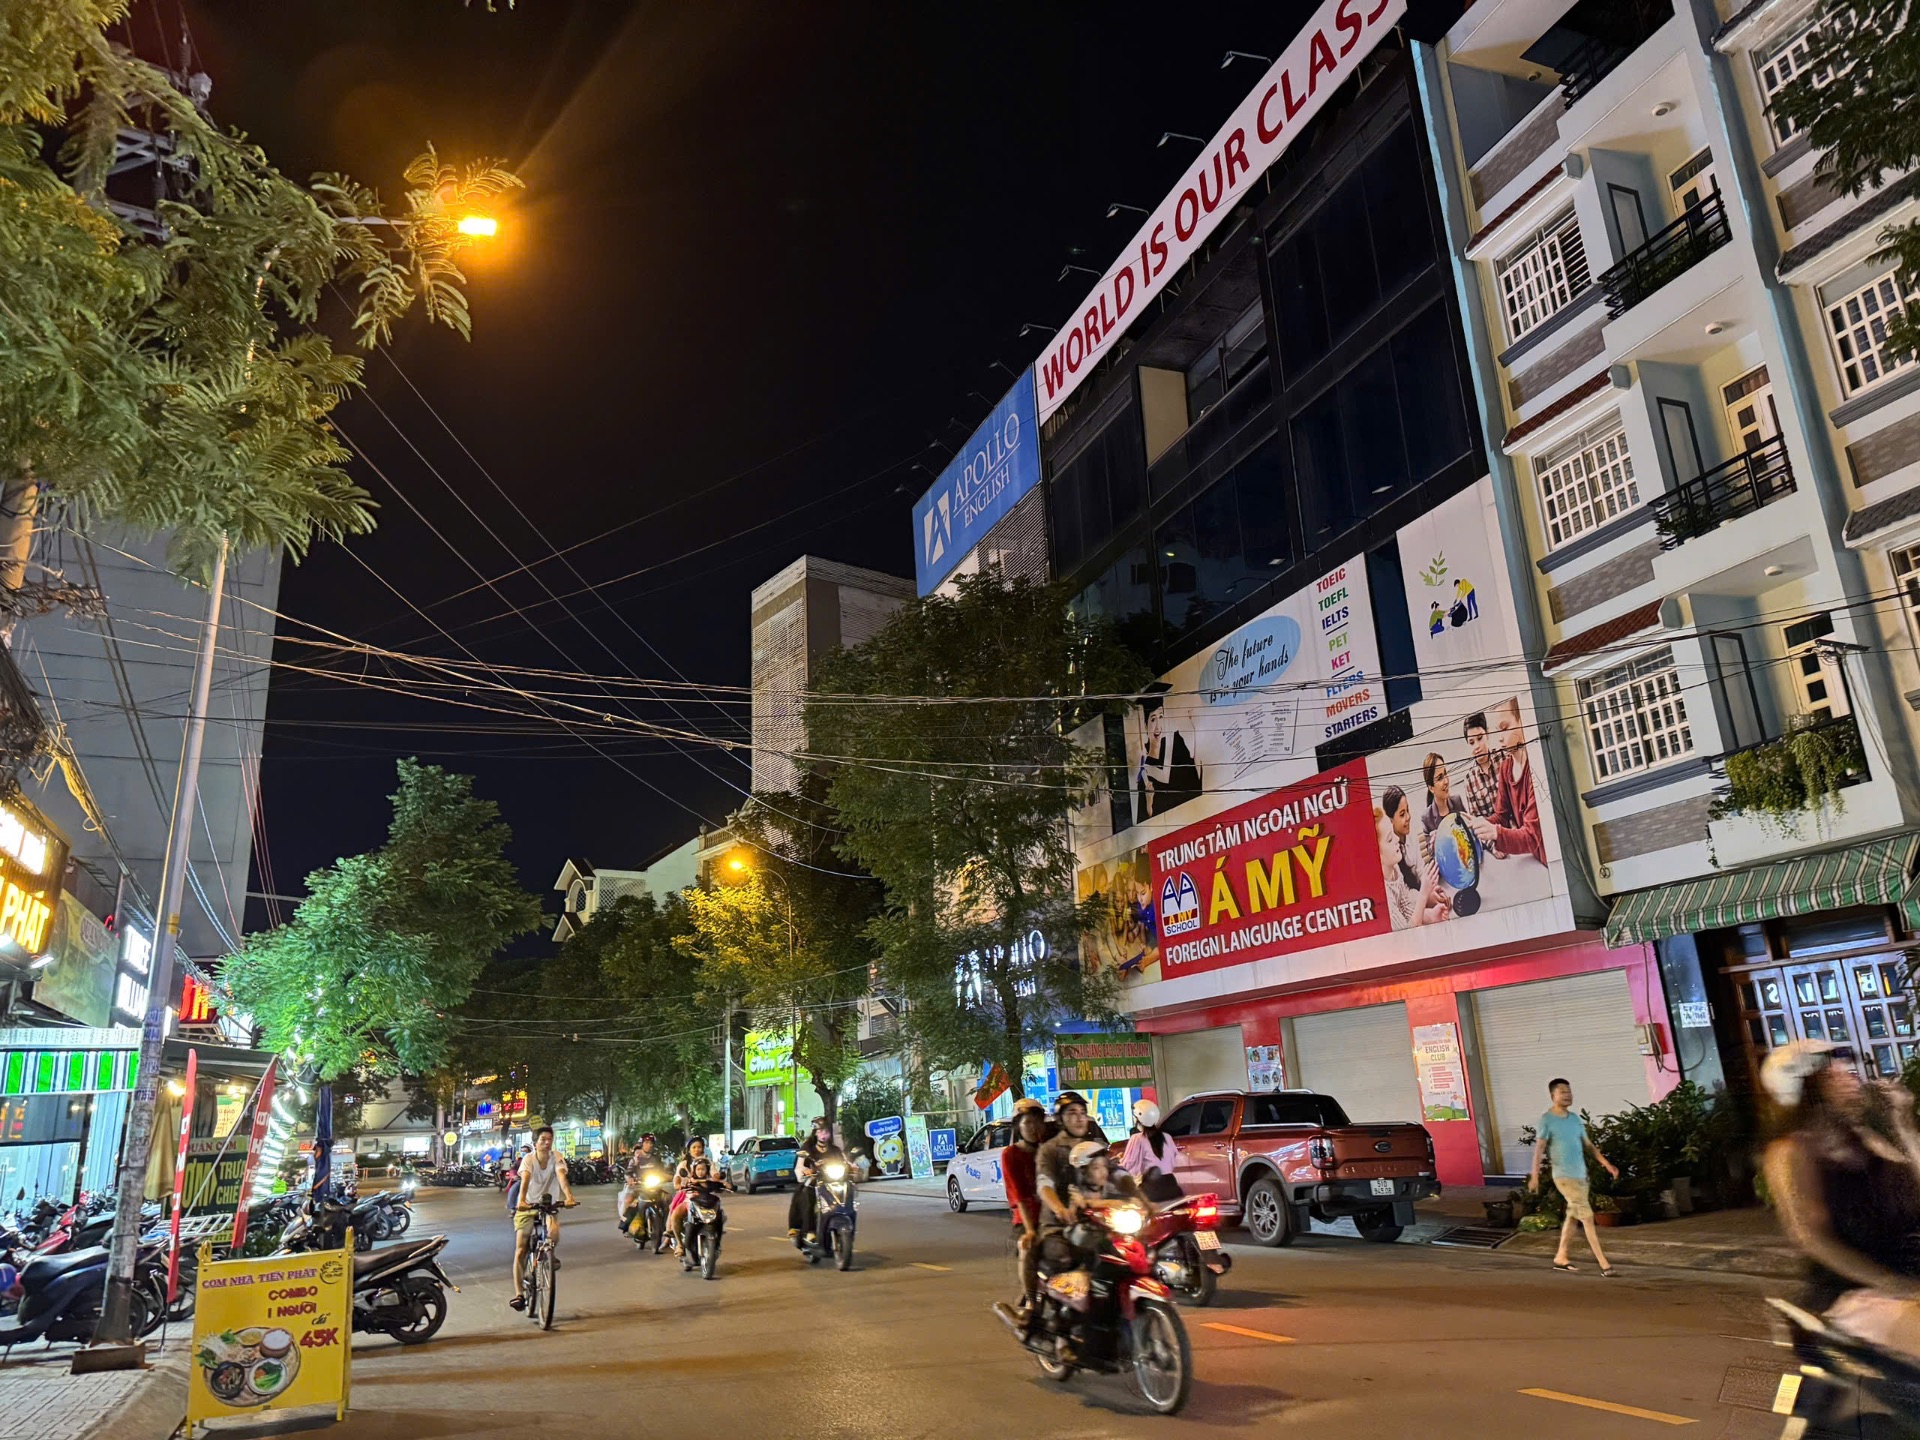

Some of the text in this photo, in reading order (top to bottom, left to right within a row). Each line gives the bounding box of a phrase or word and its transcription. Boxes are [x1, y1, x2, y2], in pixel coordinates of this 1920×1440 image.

[1043, 266, 1135, 400] WORLD
[1140, 221, 1168, 288] IS
[1175, 127, 1250, 242] OUR
[953, 412, 1020, 512] APOLLO
[964, 464, 1010, 528] ENGLISH
[1316, 567, 1346, 593] TOEIC
[1318, 587, 1349, 612] TOEFL
[1321, 605, 1349, 630] IELTS
[1328, 631, 1348, 652] PET
[1216, 634, 1273, 680] The future
[1331, 650, 1351, 671] KET
[1232, 671, 1255, 699] your
[1258, 643, 1289, 678] hands
[1326, 688, 1371, 718] MOVERS
[1325, 706, 1378, 738] STARTERS
[1157, 776, 1350, 872] TRUNG TÂM NGOẠI NGỮ
[1209, 823, 1331, 925] Á MỸ
[0, 881, 50, 954] PHÁT
[1166, 918, 1198, 935] SCHOOL
[1166, 898, 1374, 966] FOREIGN LANGUAGE CENTER
[1425, 1045, 1450, 1054] ENGLISH
[1430, 1053, 1446, 1062] CLUB
[1077, 1060, 1093, 1081] 20%
[933, 1145, 953, 1153] APOLLO
[268, 1286, 318, 1301] COMBO
[300, 1328, 339, 1348] 45K
